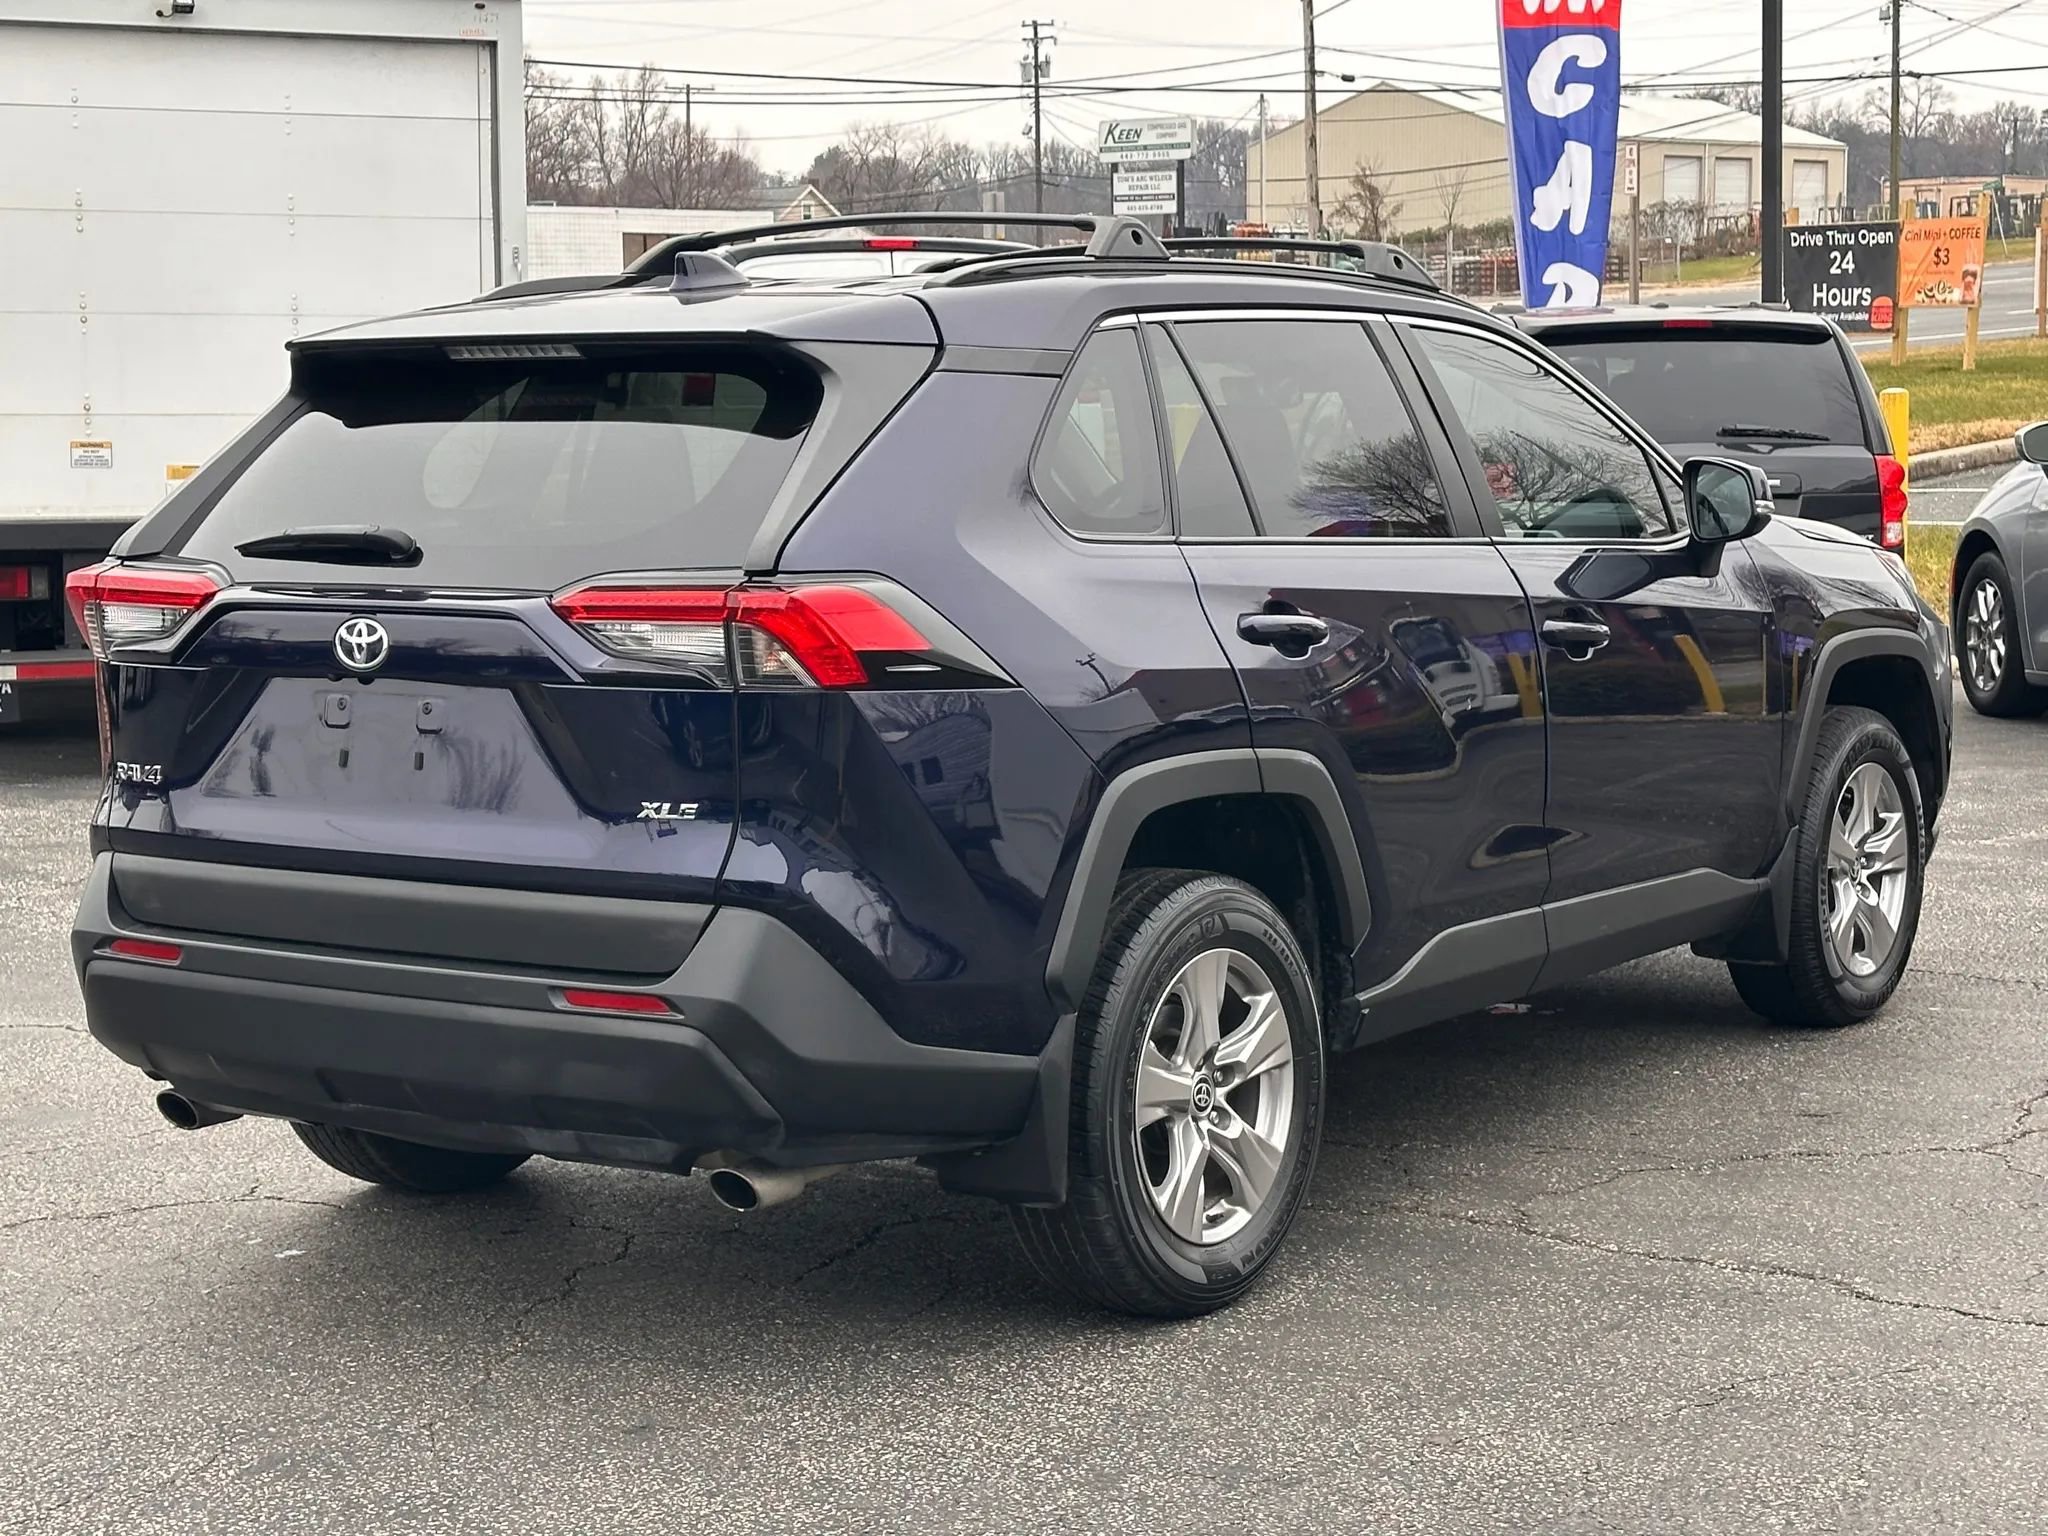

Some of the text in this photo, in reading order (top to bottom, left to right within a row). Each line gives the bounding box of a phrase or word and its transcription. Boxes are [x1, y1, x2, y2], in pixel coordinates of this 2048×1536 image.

[1790, 229, 1893, 247] Drive Thru Open
[1949, 227, 1981, 240] COFFEE
[1829, 250, 1855, 275] 24
[1933, 246, 1950, 268] $3
[1813, 284, 1871, 307] Hours
[116, 761, 162, 785] RAV4
[636, 801, 699, 819] XLE
